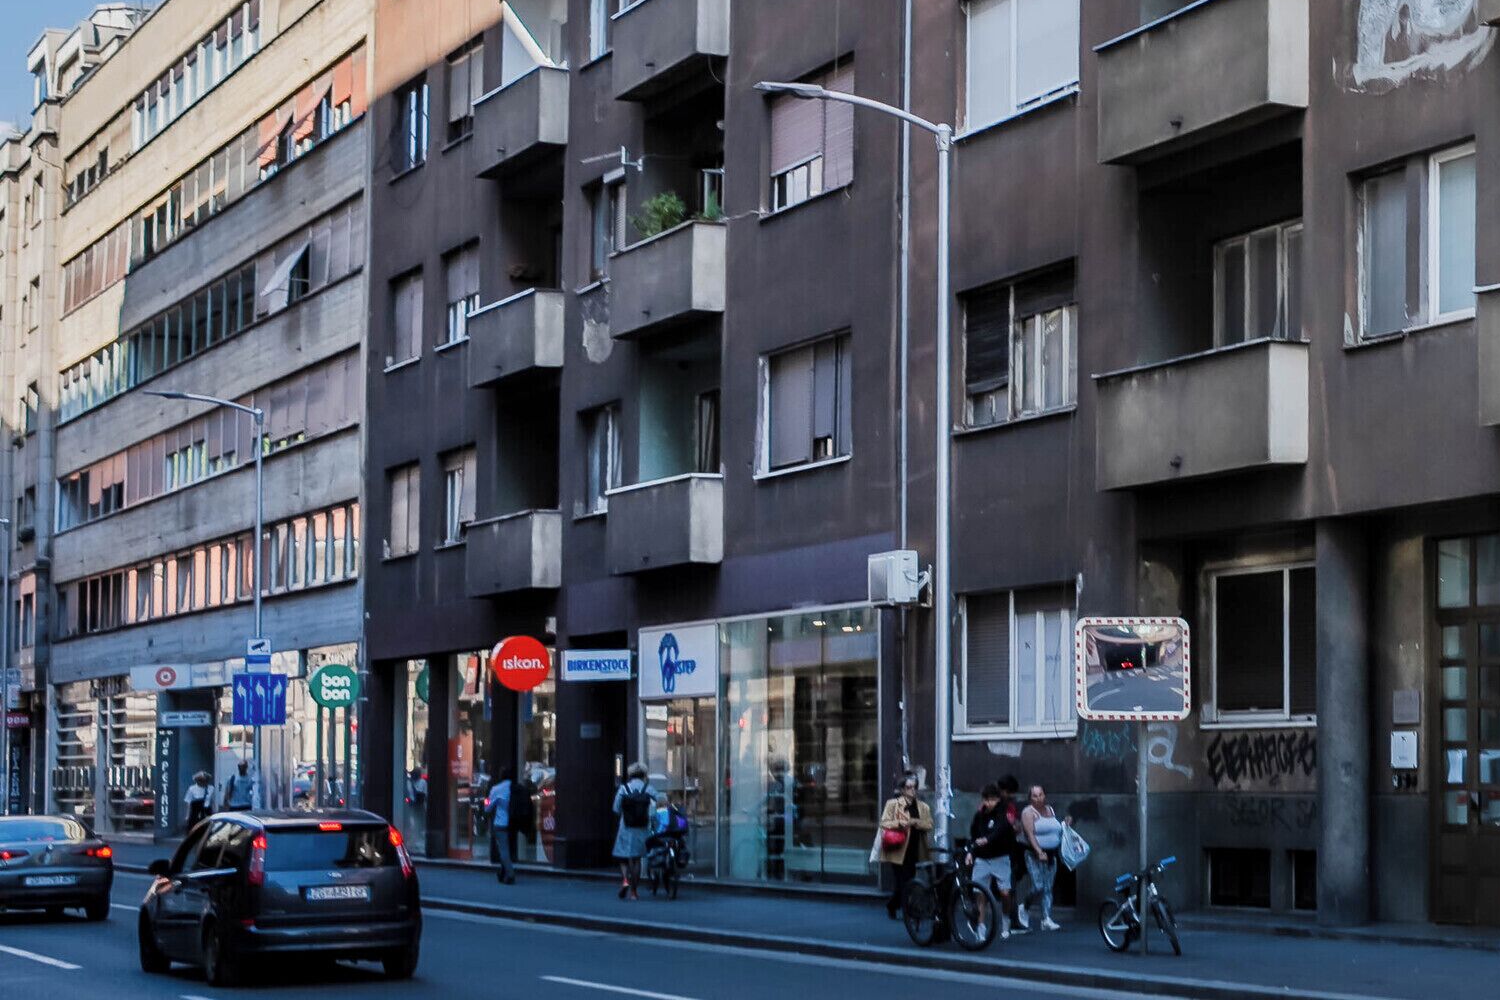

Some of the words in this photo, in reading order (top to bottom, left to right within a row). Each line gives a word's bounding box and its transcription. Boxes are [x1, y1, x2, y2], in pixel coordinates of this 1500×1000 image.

[567, 658, 629, 672] BIRKENSTOCK
[321, 672, 351, 687] bon
[321, 686, 351, 701] bon
